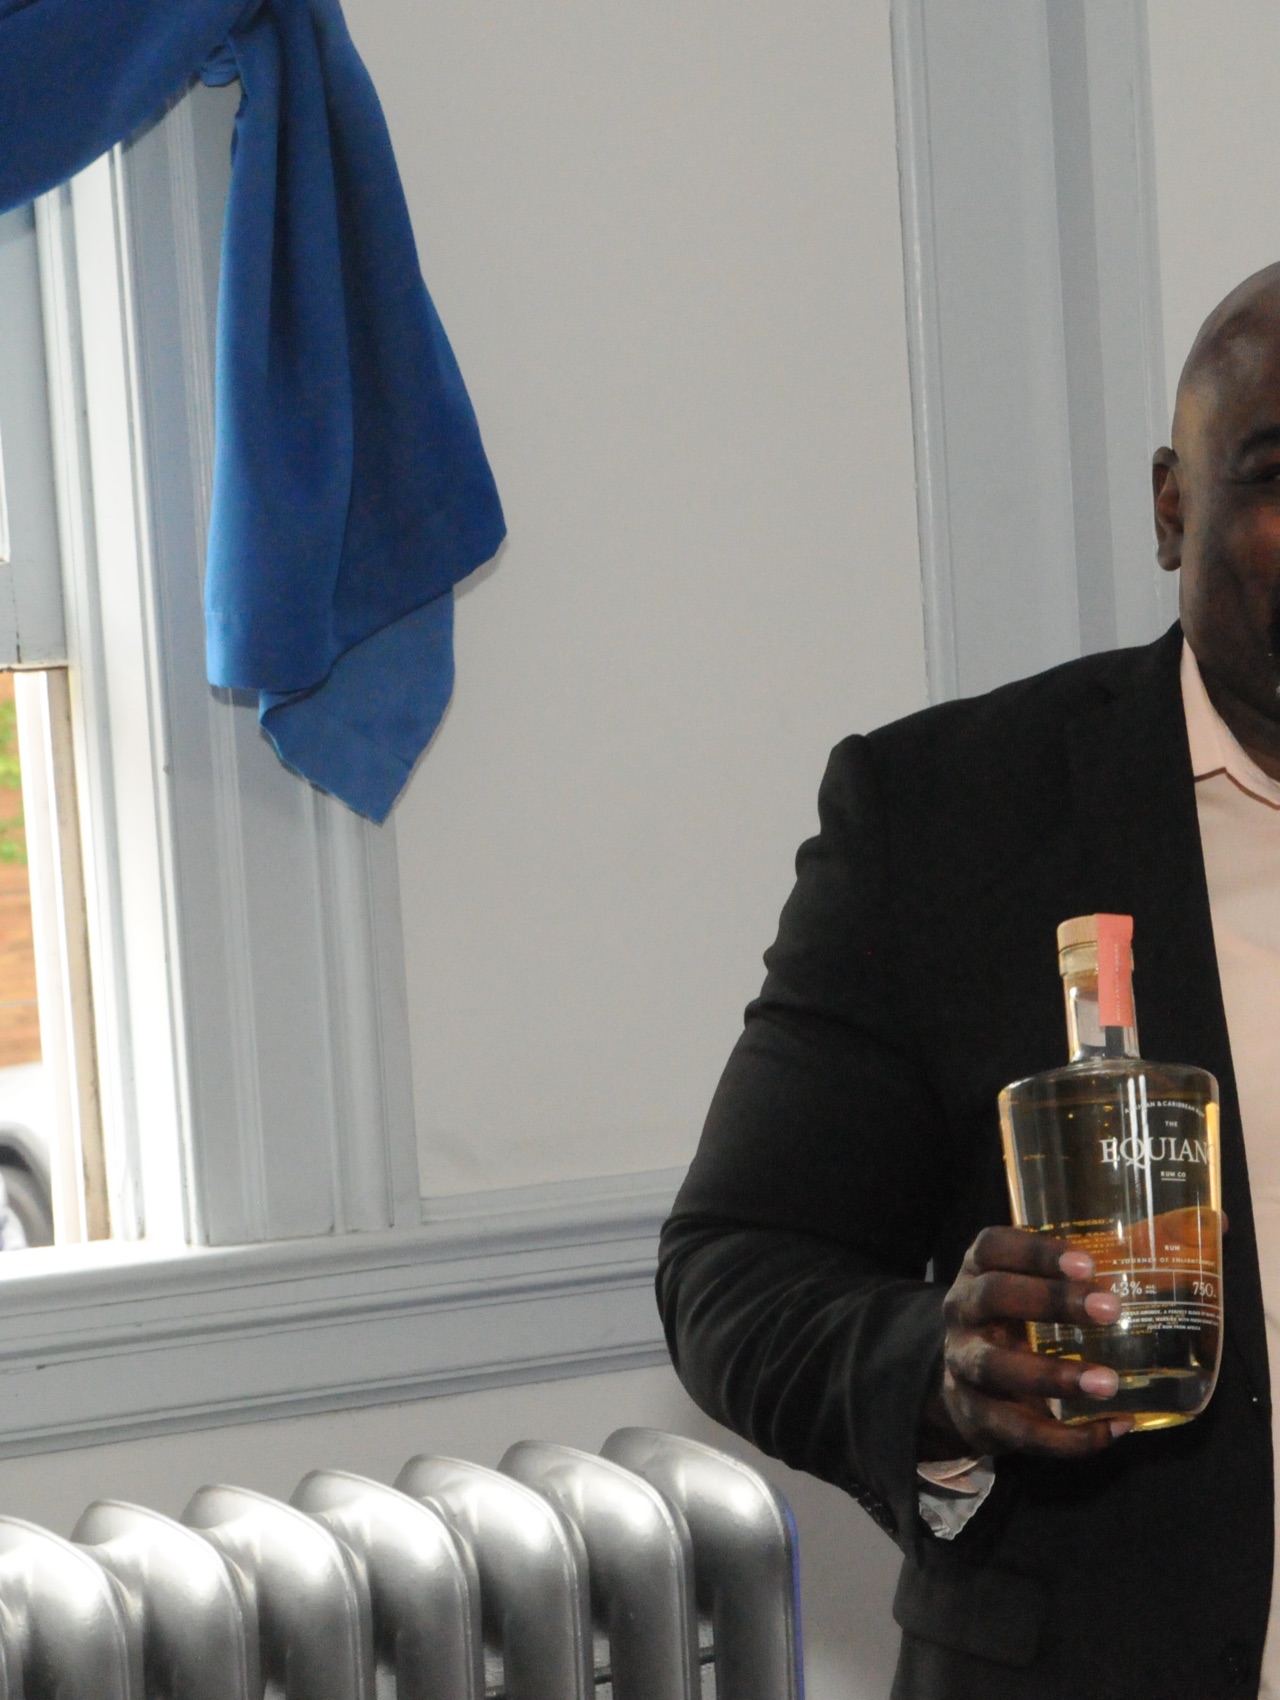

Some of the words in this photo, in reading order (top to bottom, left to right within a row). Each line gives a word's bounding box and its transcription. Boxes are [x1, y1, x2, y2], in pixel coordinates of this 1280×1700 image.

[1165, 1120, 1178, 1128] THE
[1098, 1136, 1209, 1169] EQUIAN
[1192, 1281, 1214, 1298] 750
